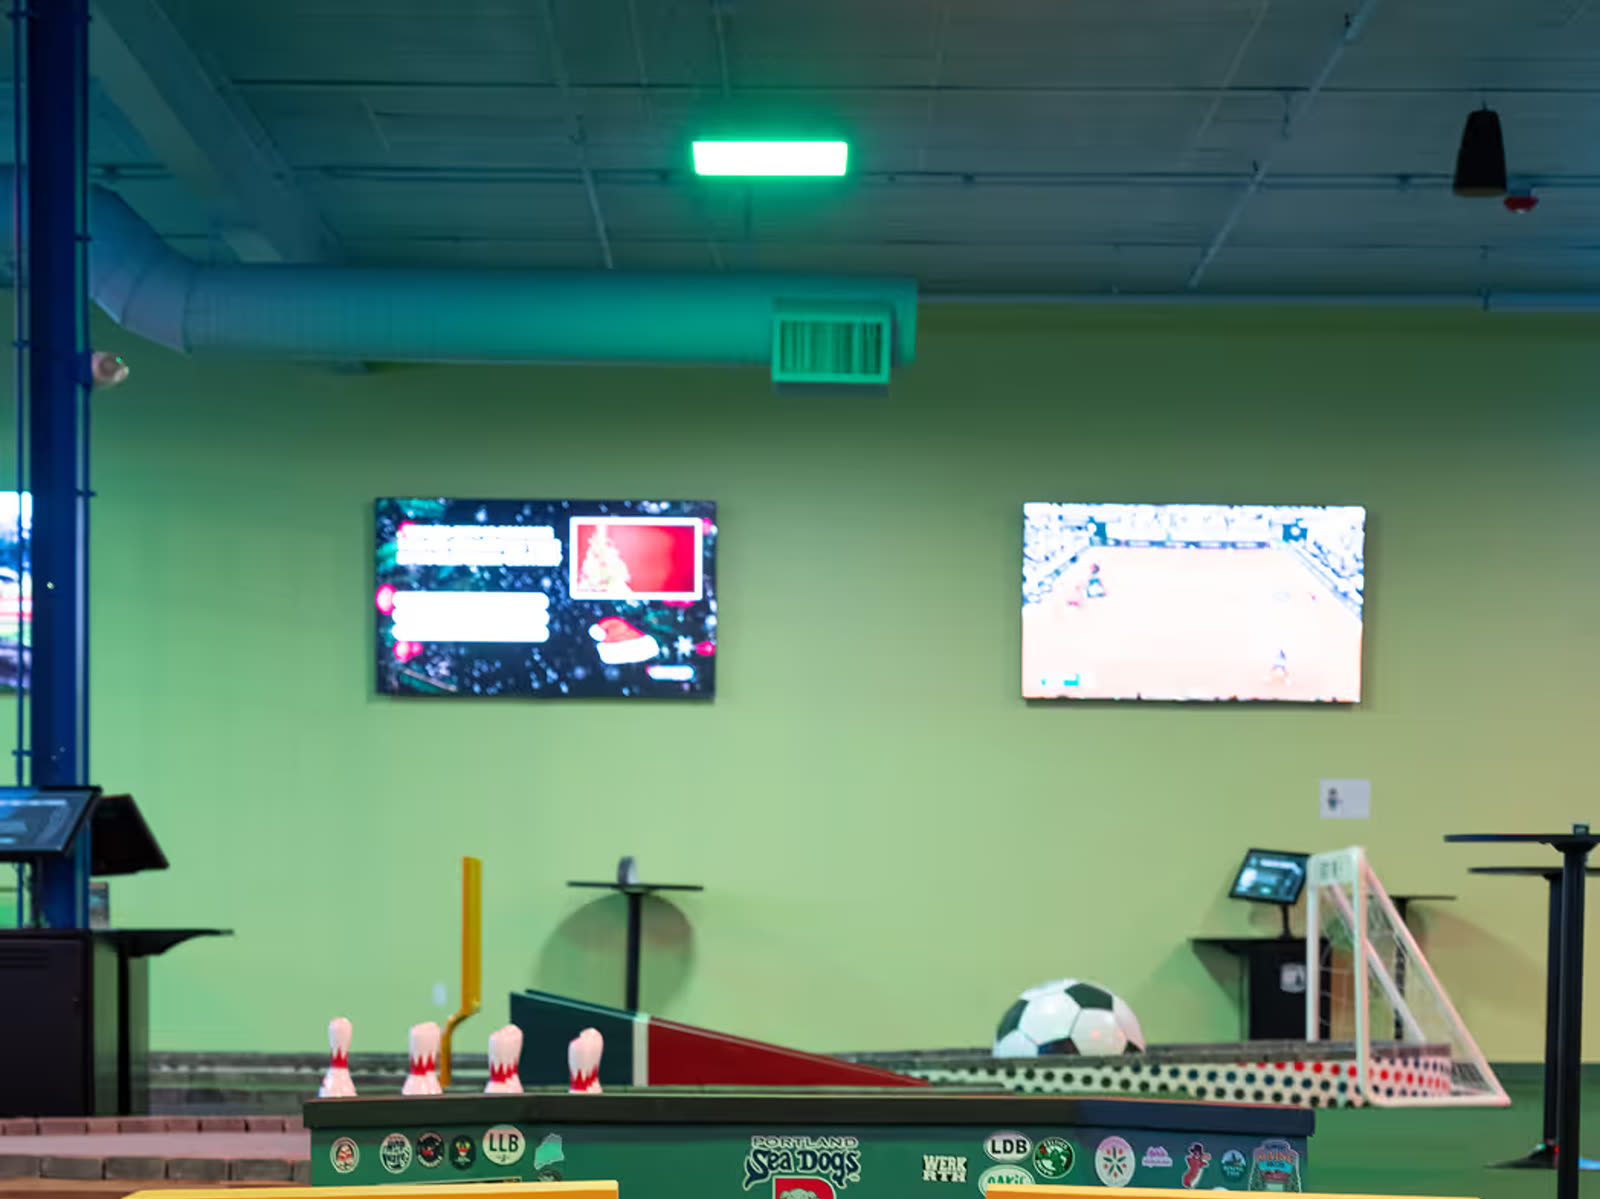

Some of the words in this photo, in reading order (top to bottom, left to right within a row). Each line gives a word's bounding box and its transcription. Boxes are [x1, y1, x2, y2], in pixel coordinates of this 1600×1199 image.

[489, 1133, 519, 1152] LLB
[752, 1136, 858, 1149] PORTLAND
[991, 1139, 1027, 1154] LDB
[743, 1149, 794, 1190] Sea
[795, 1149, 861, 1188] Dogs
[923, 1155, 967, 1170] WERK
